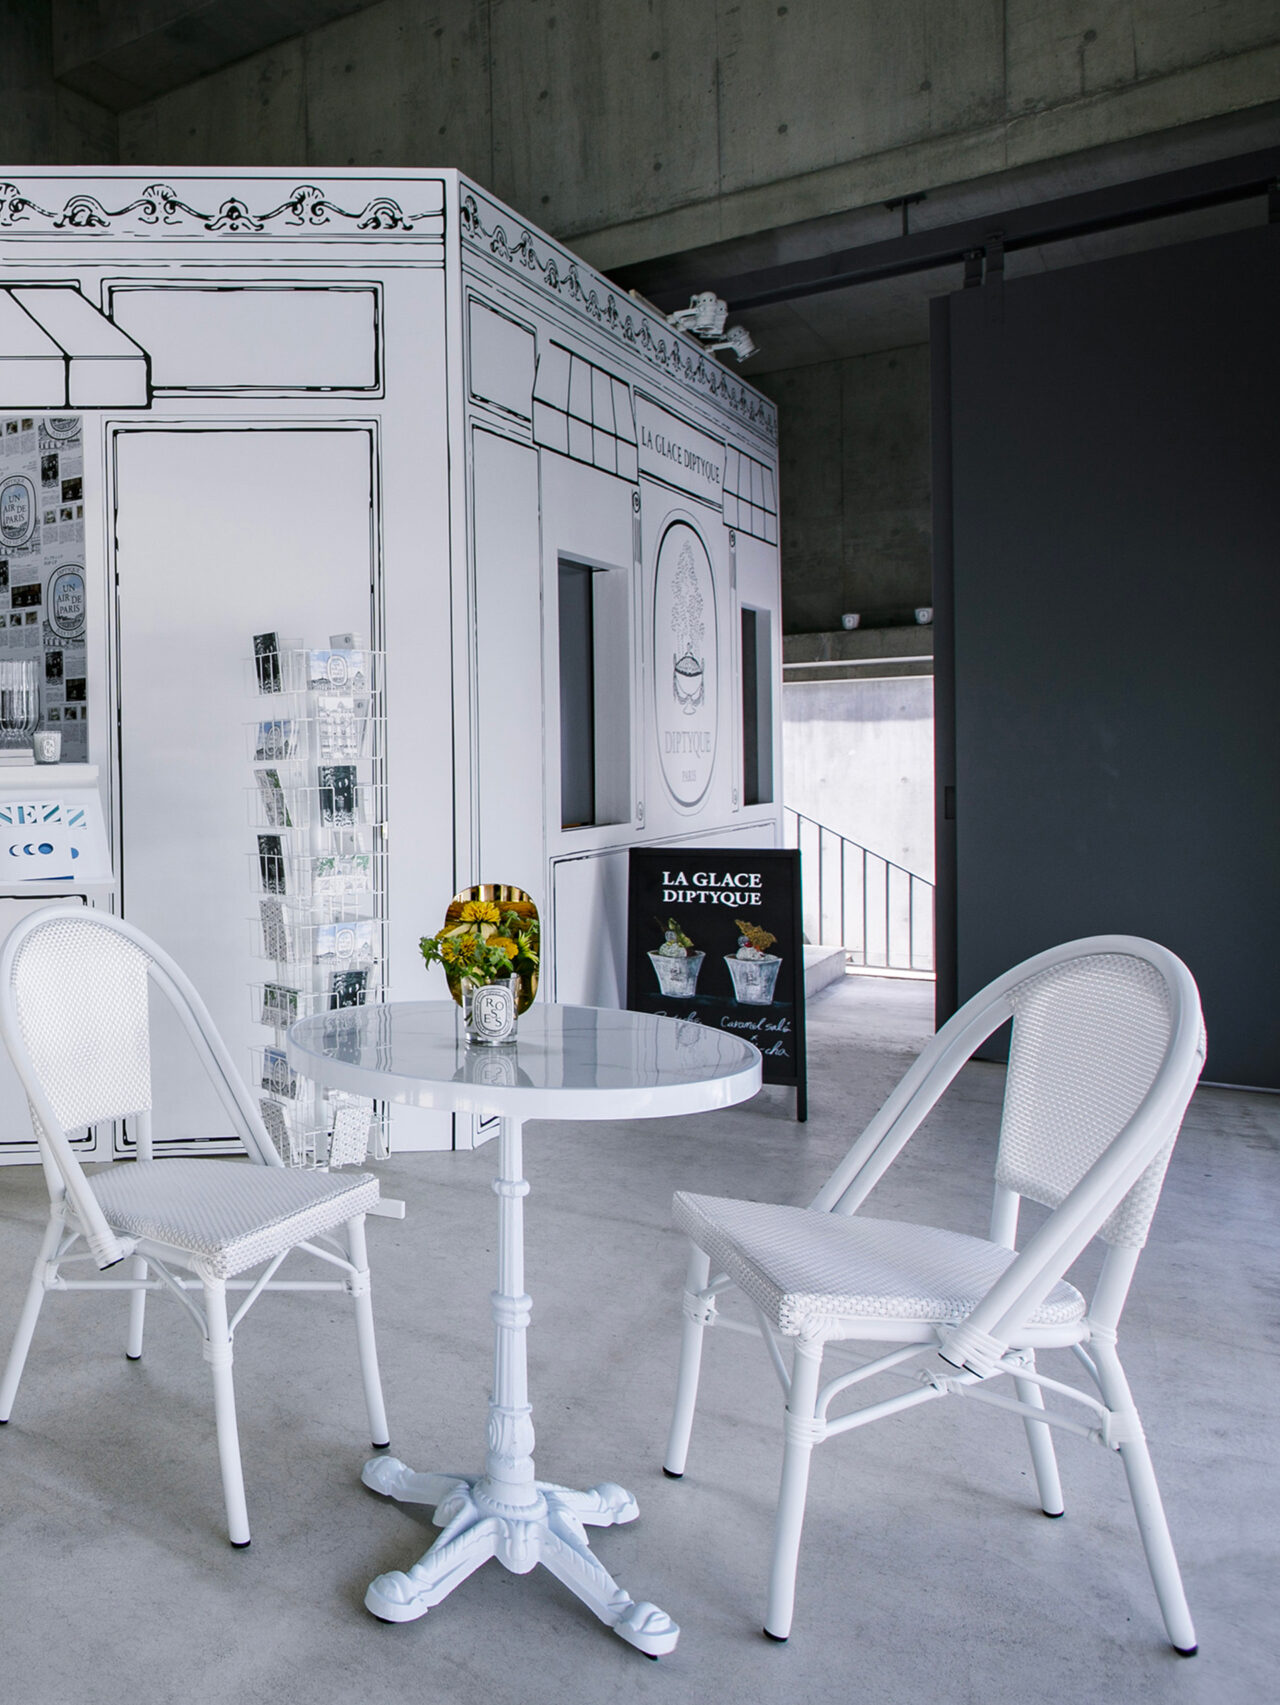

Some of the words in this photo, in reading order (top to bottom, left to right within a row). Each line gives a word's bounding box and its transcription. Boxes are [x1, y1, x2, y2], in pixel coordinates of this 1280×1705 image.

[642, 426, 654, 450] LA
[655, 434, 682, 464] GLACE
[684, 448, 720, 484] DIPTYQUE
[62, 583, 76, 592] UN
[72, 595, 82, 604] DE
[59, 604, 81, 614] PARIS
[664, 731, 711, 759] DIPTYQUE
[662, 871, 689, 886] LA
[692, 872, 763, 888] GLACE
[662, 889, 762, 908] DIPTYQUE
[720, 1016, 766, 1030] Caramel
